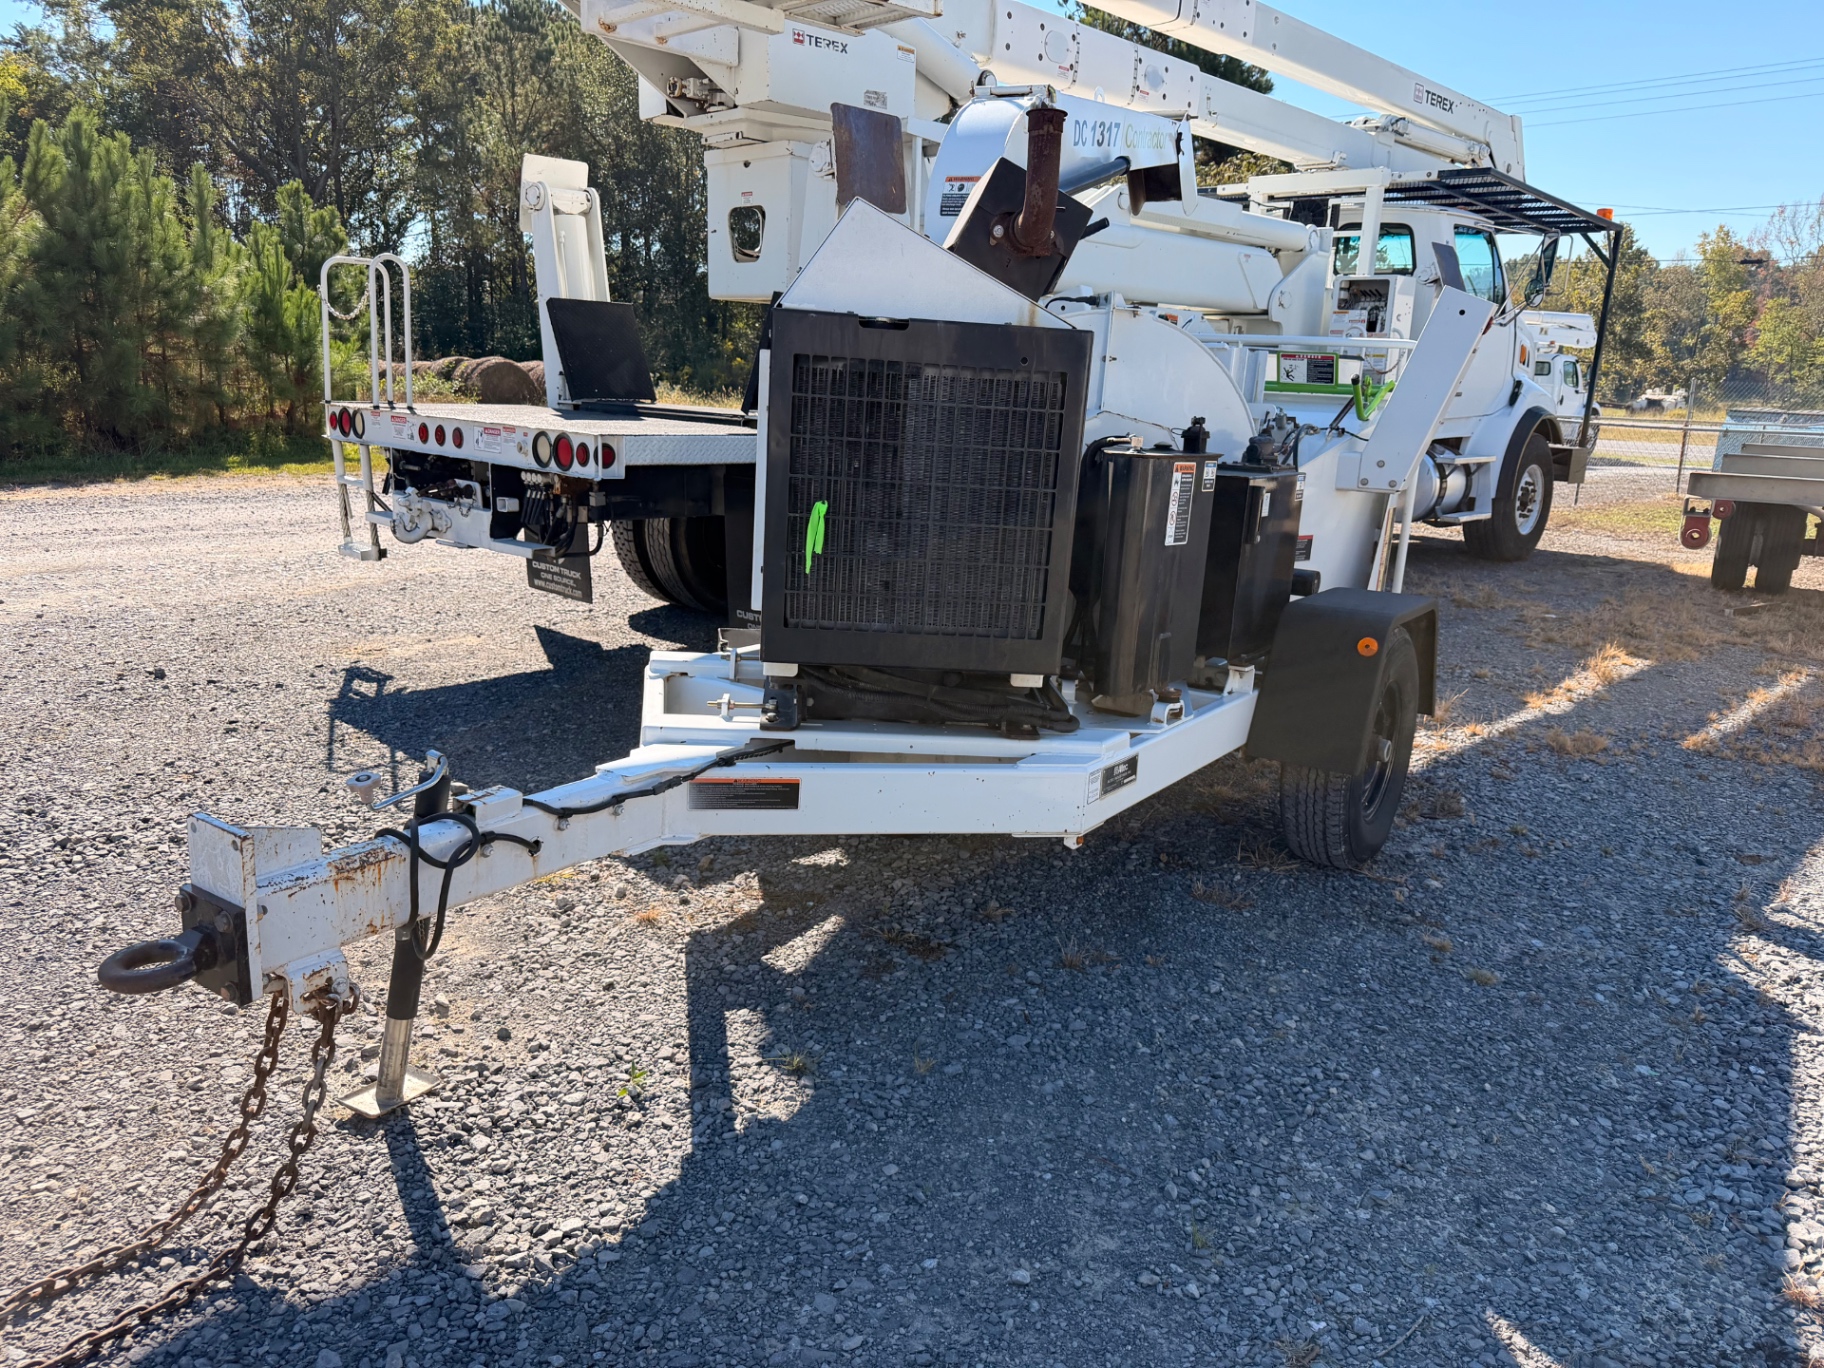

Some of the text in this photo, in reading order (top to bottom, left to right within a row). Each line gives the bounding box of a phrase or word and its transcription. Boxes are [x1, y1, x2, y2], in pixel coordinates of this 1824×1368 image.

[806, 34, 848, 54] TEREX
[1425, 90, 1454, 114] TEREX
[1073, 120, 1170, 149] DC 1317 Contractor
[532, 561, 581, 580] CUSTOM TRUCK
